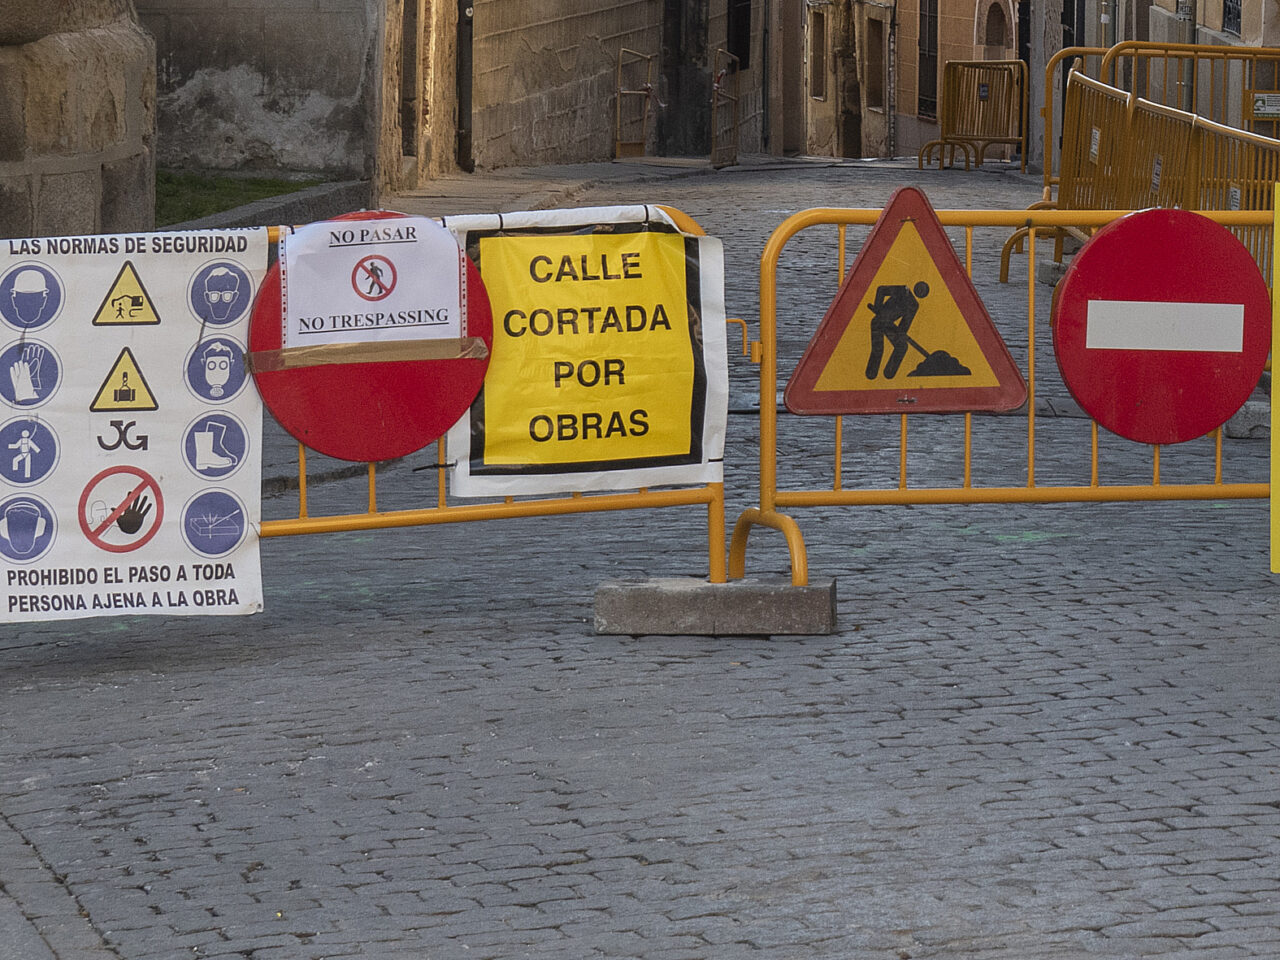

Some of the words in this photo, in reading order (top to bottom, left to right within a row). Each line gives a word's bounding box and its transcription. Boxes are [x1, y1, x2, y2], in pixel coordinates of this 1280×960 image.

[9, 240, 41, 255] LAS
[46, 238, 119, 254] NORMAS
[125, 237, 147, 253] DE
[152, 235, 248, 253] SEGURIDAD
[329, 230, 356, 244] NO
[360, 226, 417, 243] PASAR
[529, 252, 642, 283] CALLE
[299, 317, 325, 331] NO
[328, 308, 448, 328] TRESPASSING
[503, 304, 671, 337] CORTADA
[554, 358, 625, 388] POR
[529, 408, 649, 442] OBRAS
[7, 567, 98, 586] PROHIBIDO
[104, 566, 124, 584] EL
[129, 565, 171, 583] PASO
[176, 565, 188, 582] A
[193, 563, 236, 581] TODA
[8, 594, 87, 613] PERSONA
[93, 592, 147, 609] AJENA
[151, 592, 163, 607] A
[167, 590, 189, 607] LA
[193, 588, 240, 607] OBRA
